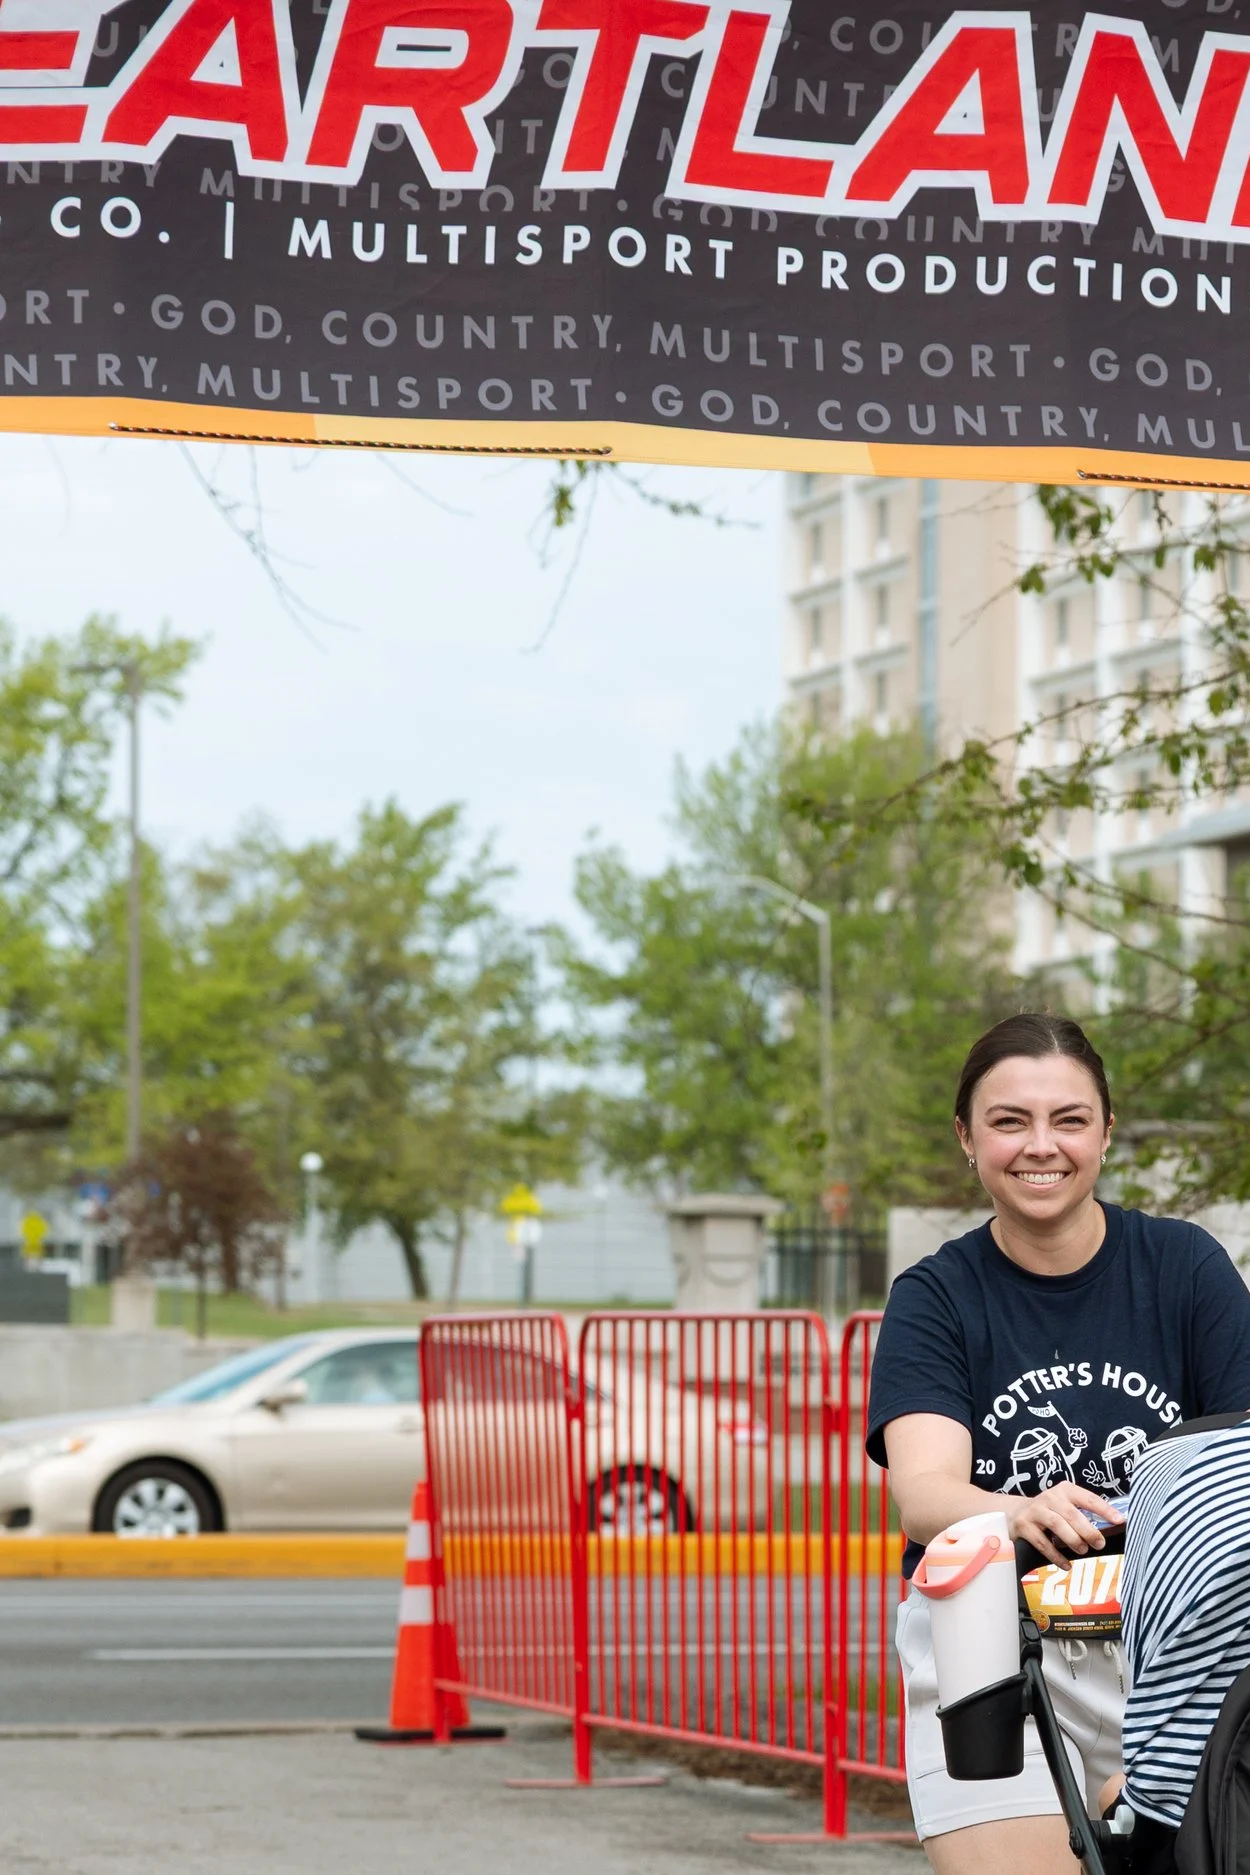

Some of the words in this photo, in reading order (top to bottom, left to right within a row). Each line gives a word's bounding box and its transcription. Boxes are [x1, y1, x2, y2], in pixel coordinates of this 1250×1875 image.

[50, 196, 171, 244] CO.
[288, 216, 734, 280] MULTISPORT
[151, 293, 292, 344] GOD,
[321, 309, 622, 353] COUNTRY,
[649, 321, 1031, 378] MULTISPORT
[1088, 347, 1222, 397] GOD,
[196, 362, 593, 412] MULTISPORT
[652, 383, 790, 431] GOD,
[816, 399, 1110, 443] COUNTRY,
[981, 1361, 1094, 1438] POTTER'S
[975, 1459, 996, 1475] 20
